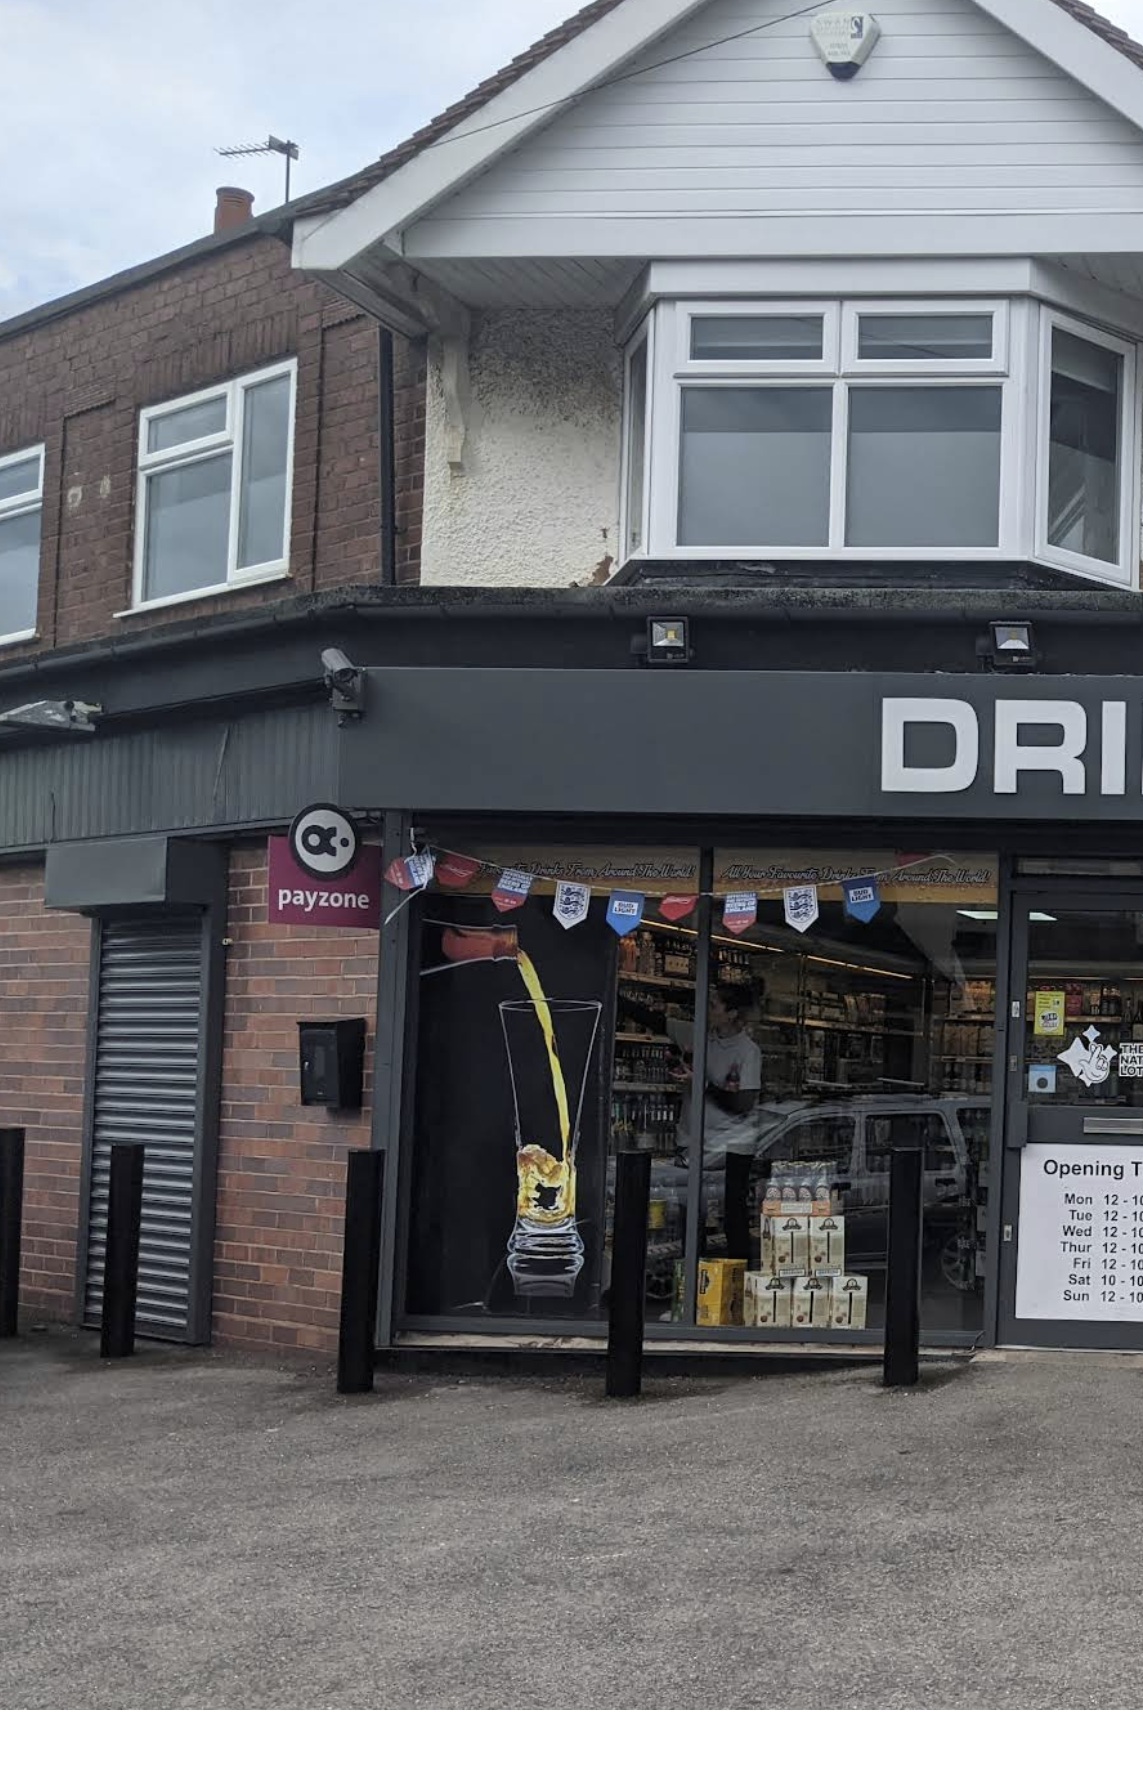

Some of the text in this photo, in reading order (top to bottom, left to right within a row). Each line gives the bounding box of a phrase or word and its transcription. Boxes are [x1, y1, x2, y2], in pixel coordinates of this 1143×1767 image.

[278, 888, 370, 912] payzone
[1043, 1159, 1125, 1180] Opening
[1064, 1193, 1093, 1205] Mon
[1104, 1194, 1119, 1206] 12
[1069, 1209, 1093, 1221] Tue
[1103, 1210, 1119, 1222] 12
[1062, 1225, 1092, 1237] Wed
[1102, 1226, 1118, 1238] 12
[1060, 1241, 1092, 1253] Thur
[1102, 1242, 1118, 1254] 12
[1073, 1257, 1091, 1269] Fri
[1101, 1258, 1117, 1270] 12
[1068, 1273, 1091, 1286] Sat
[1101, 1275, 1116, 1286] 10
[1063, 1289, 1090, 1301] Sun
[1100, 1291, 1116, 1302] 12
